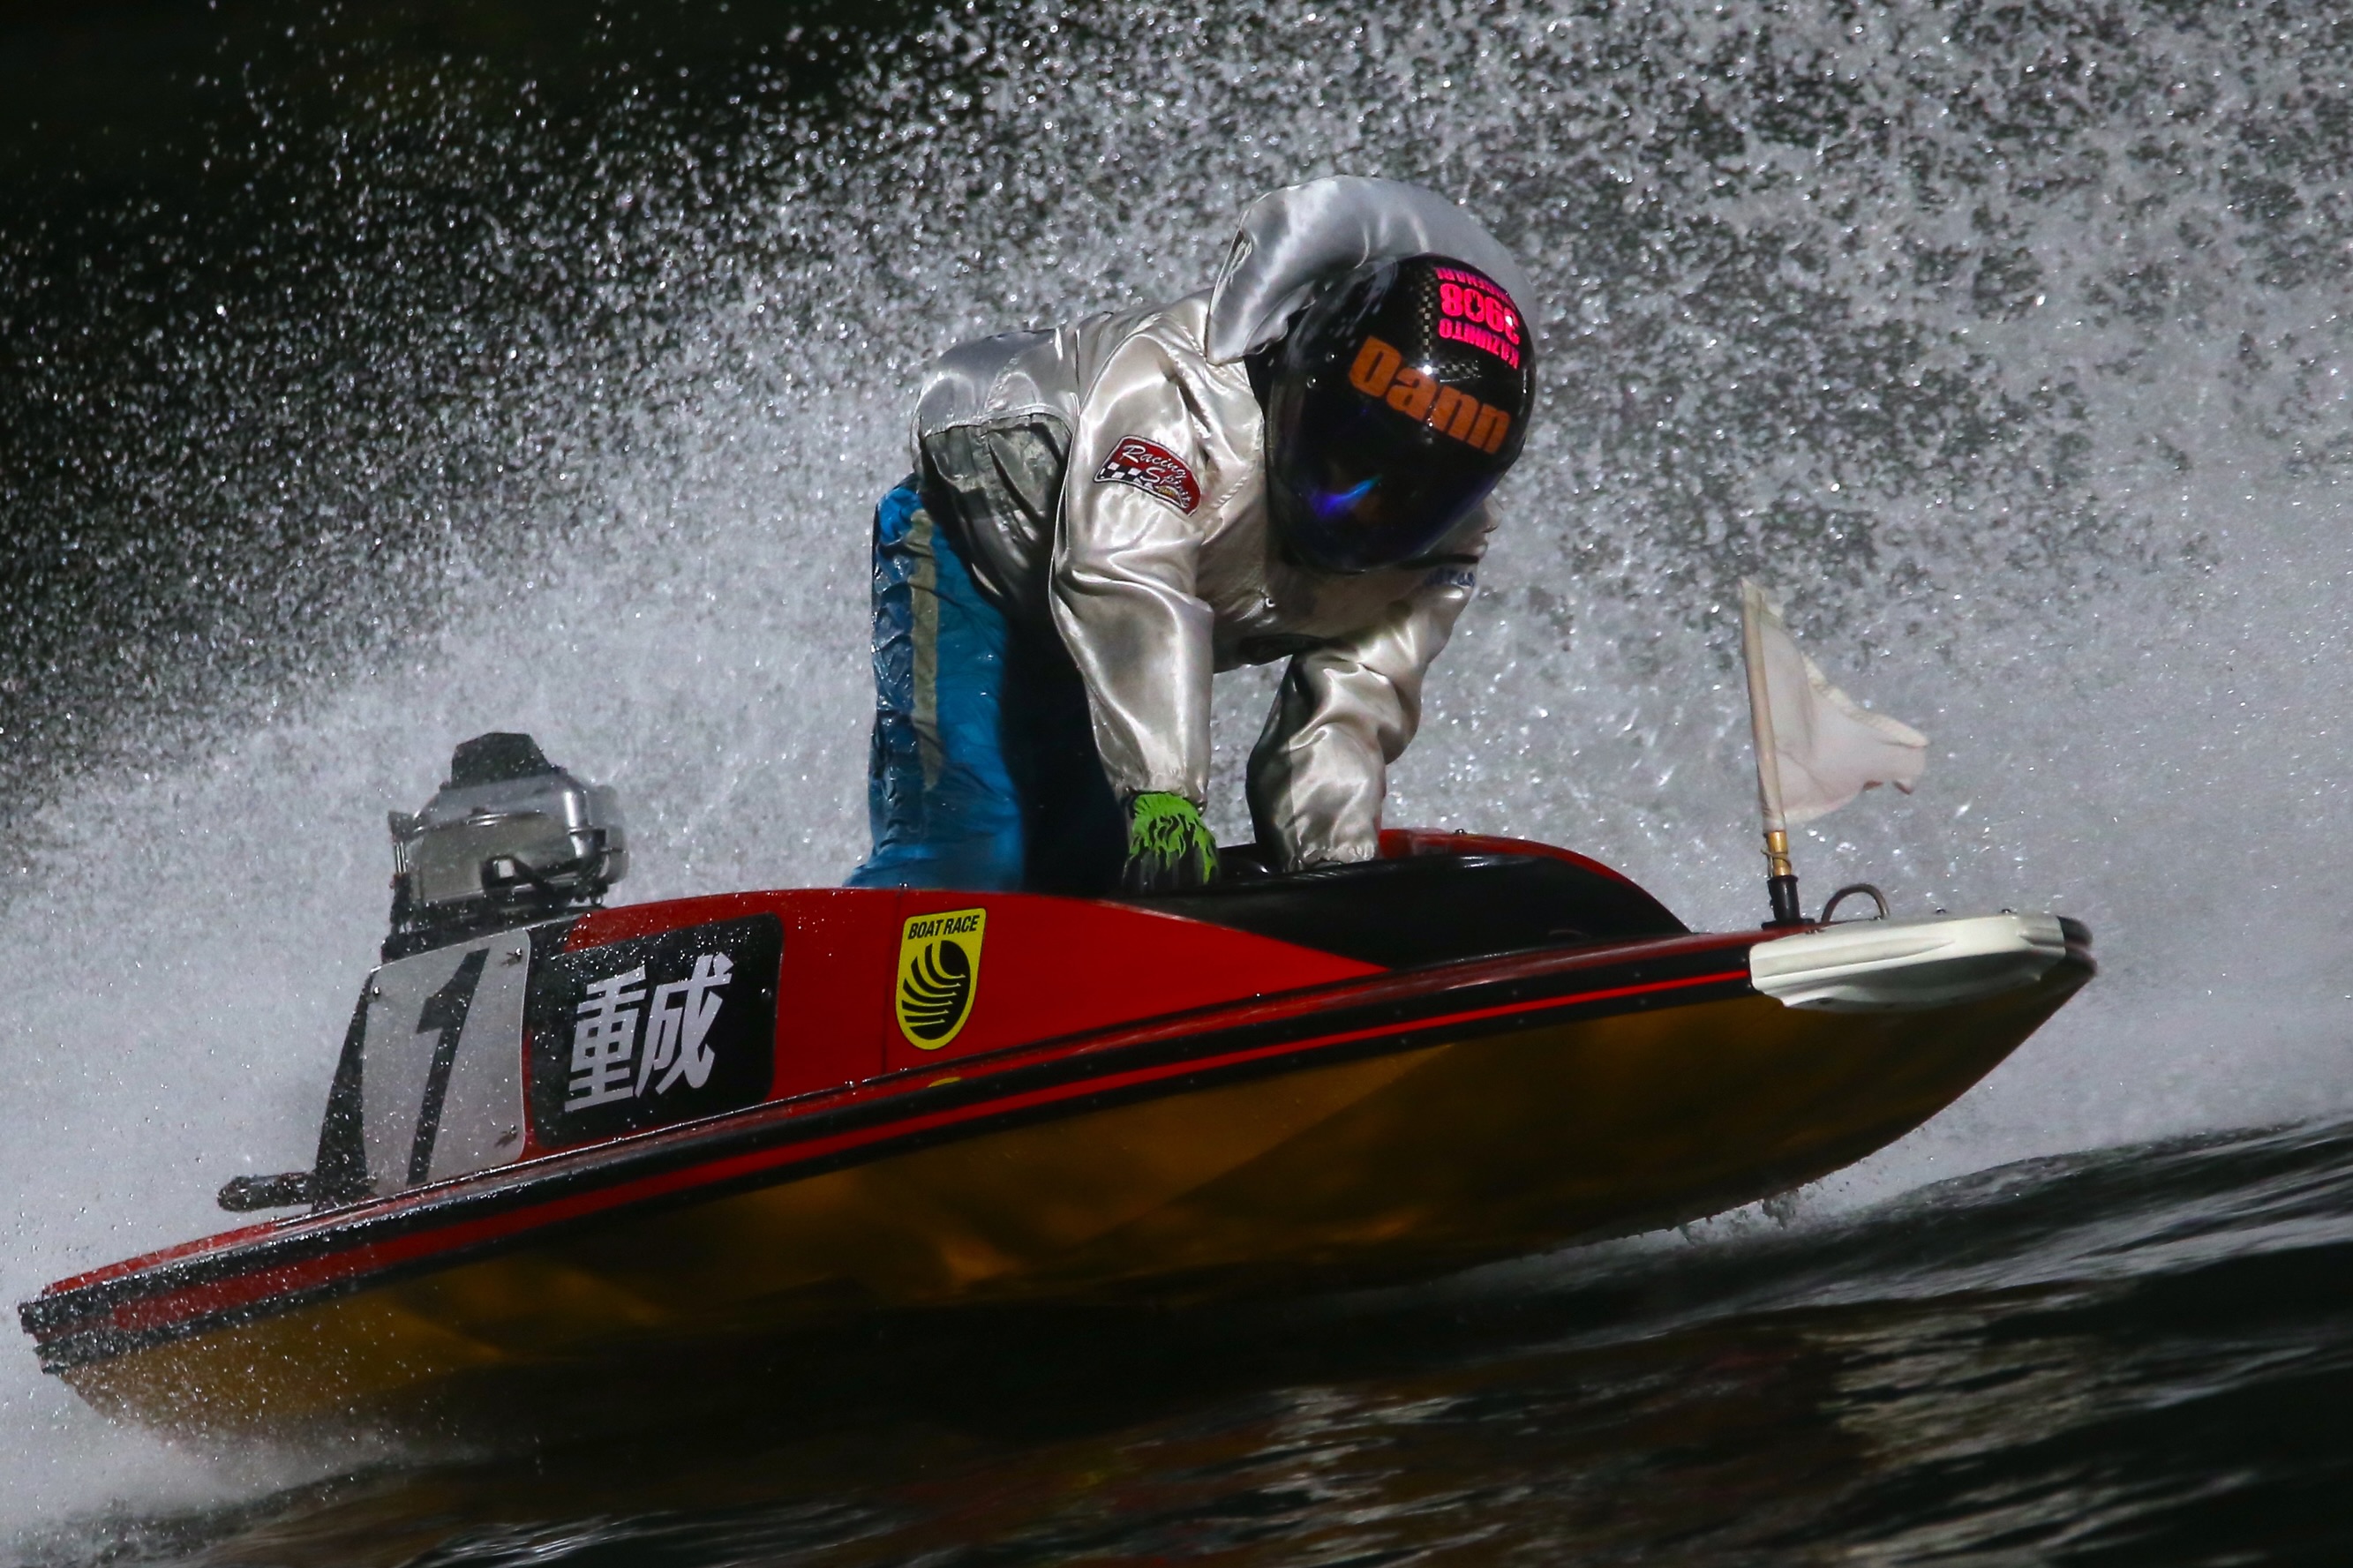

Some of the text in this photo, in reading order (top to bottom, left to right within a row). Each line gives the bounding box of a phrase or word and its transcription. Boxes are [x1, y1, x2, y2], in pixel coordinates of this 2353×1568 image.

[1440, 282, 1520, 346] 3908
[1349, 335, 1511, 454] Dann
[1119, 444, 1187, 479] Racing
[908, 915, 980, 940] BOAT RACE
[407, 948, 490, 1187] 1
[564, 952, 734, 1113] 重成
